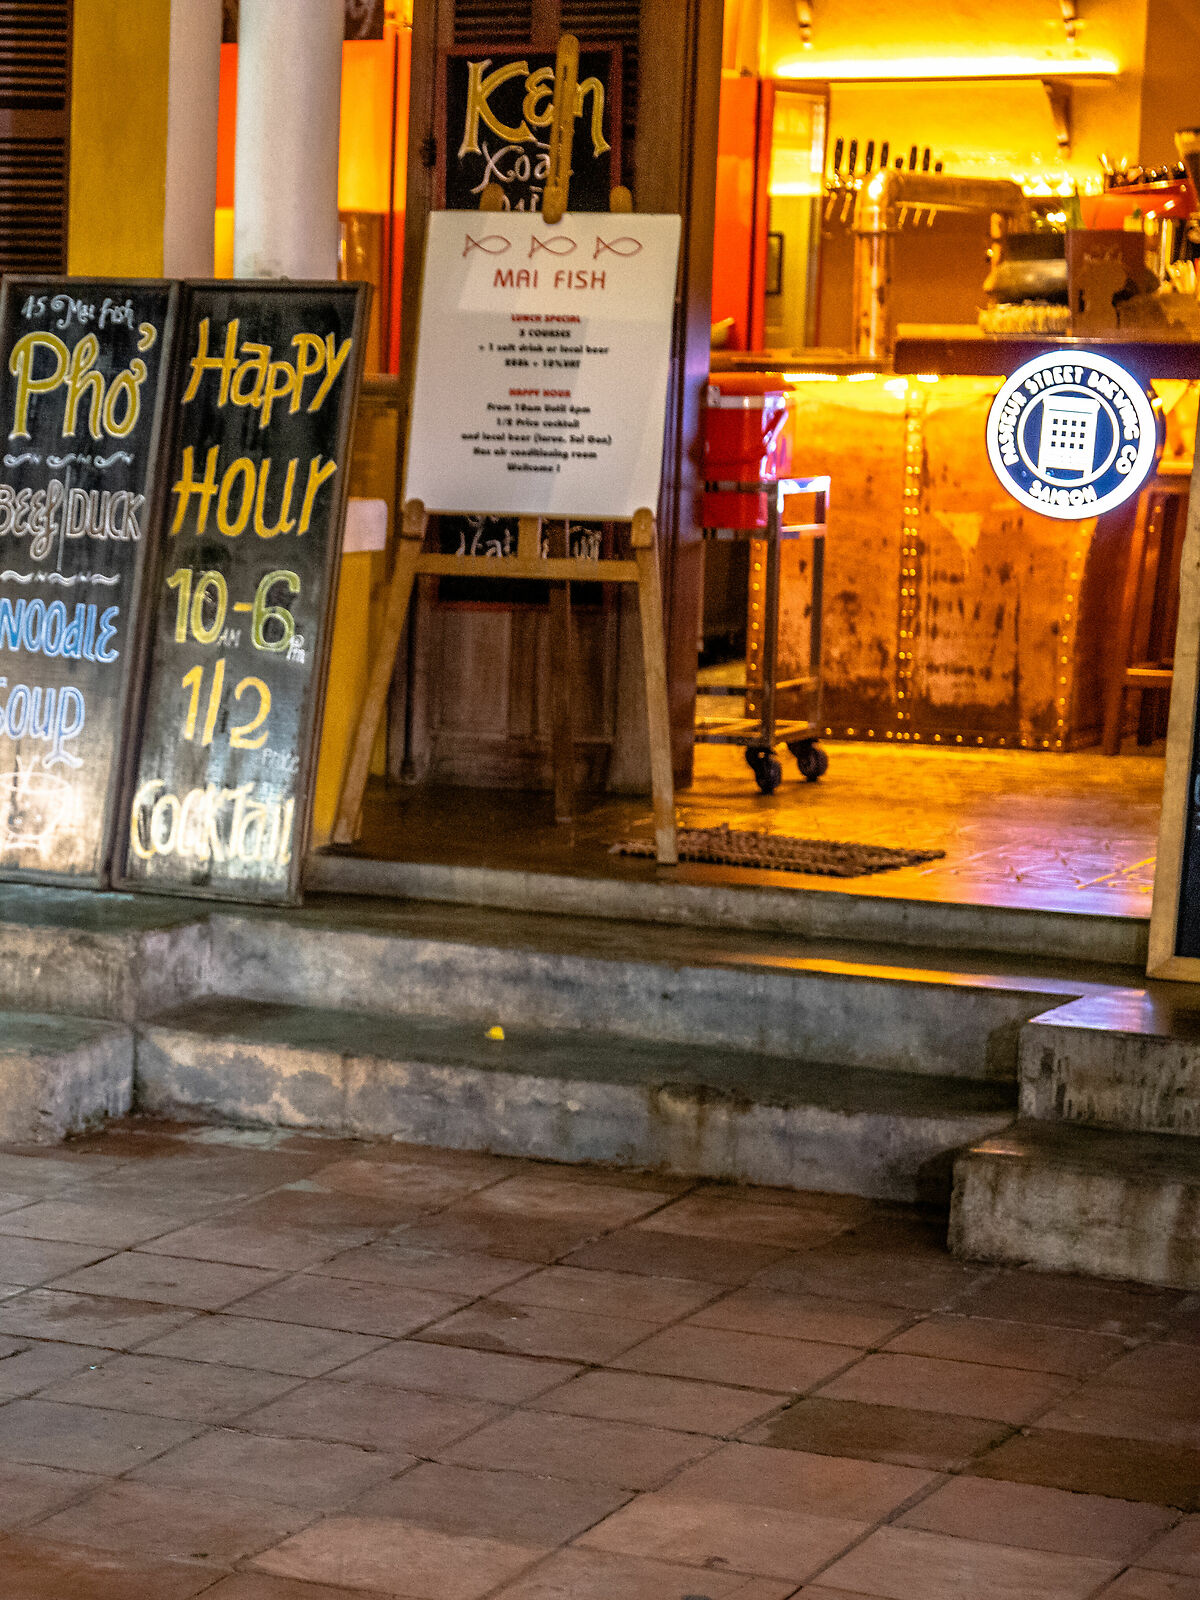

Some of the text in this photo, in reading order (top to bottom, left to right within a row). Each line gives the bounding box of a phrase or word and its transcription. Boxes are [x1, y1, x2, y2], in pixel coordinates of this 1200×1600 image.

[493, 269, 606, 290] MAI FISH
[511, 314, 581, 324] LUNCH SPECIAL
[528, 329, 571, 339] COURSES
[518, 343, 543, 353] drink
[559, 344, 583, 354] local
[586, 345, 609, 355] beer
[1025, 366, 1084, 395] STREET
[509, 388, 571, 399] HAPPY HOUR
[487, 403, 512, 412] From
[515, 403, 541, 413] 10am
[516, 418, 540, 428] Price
[542, 419, 580, 429] cocktail
[461, 431, 480, 440] and
[482, 432, 505, 441] local
[508, 433, 530, 442] beer
[571, 450, 598, 460] room
[181, 659, 272, 750] 1/2
